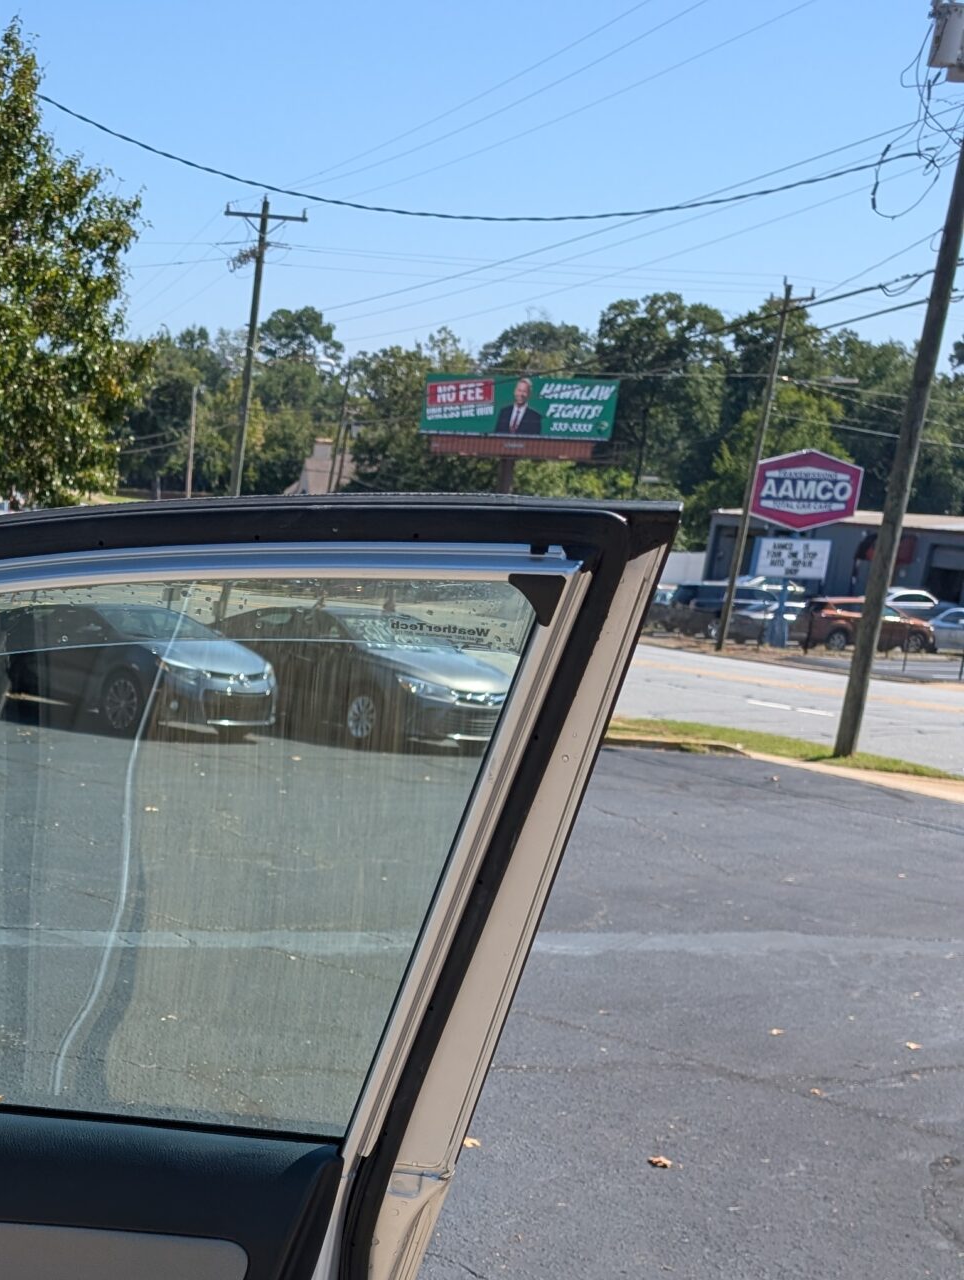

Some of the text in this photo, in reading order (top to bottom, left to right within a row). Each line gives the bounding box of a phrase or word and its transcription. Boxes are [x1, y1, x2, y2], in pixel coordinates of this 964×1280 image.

[437, 383, 483, 403] NO FEE
[760, 478, 852, 501] AAMCO
